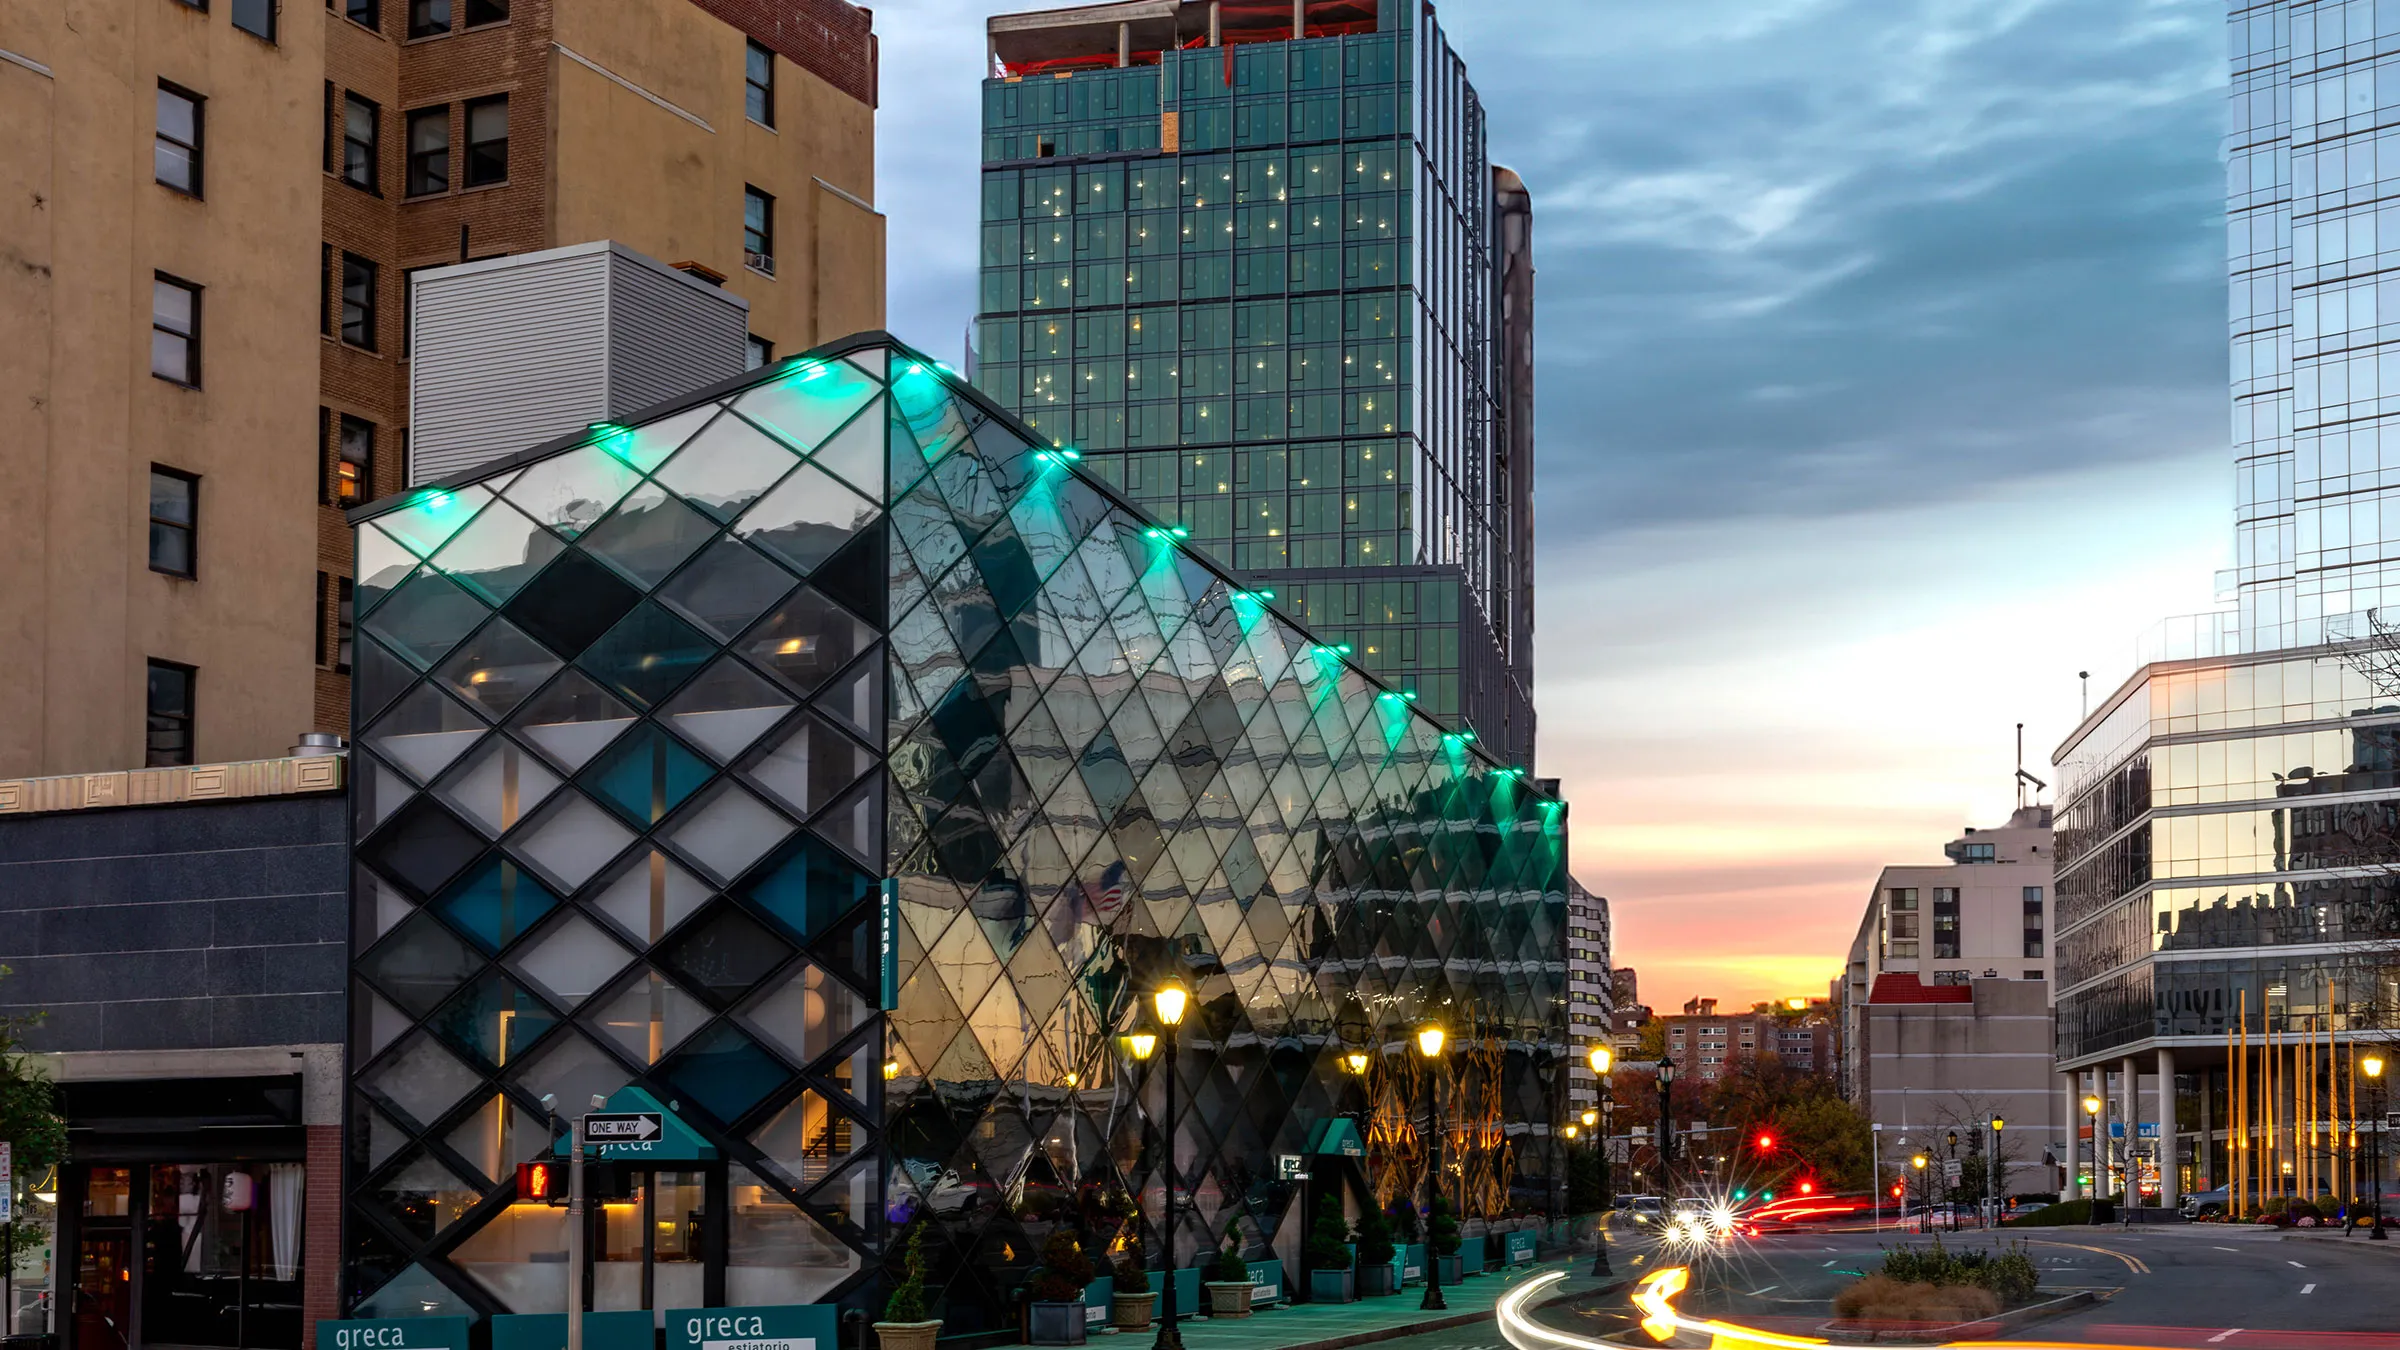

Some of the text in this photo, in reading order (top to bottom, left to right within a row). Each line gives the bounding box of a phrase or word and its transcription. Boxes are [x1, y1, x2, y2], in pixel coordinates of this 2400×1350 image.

[591, 1122, 639, 1134] ONE WAY
[335, 1326, 405, 1350] greca
[686, 1315, 765, 1344] greca
[728, 1340, 790, 1350] estiatorio
